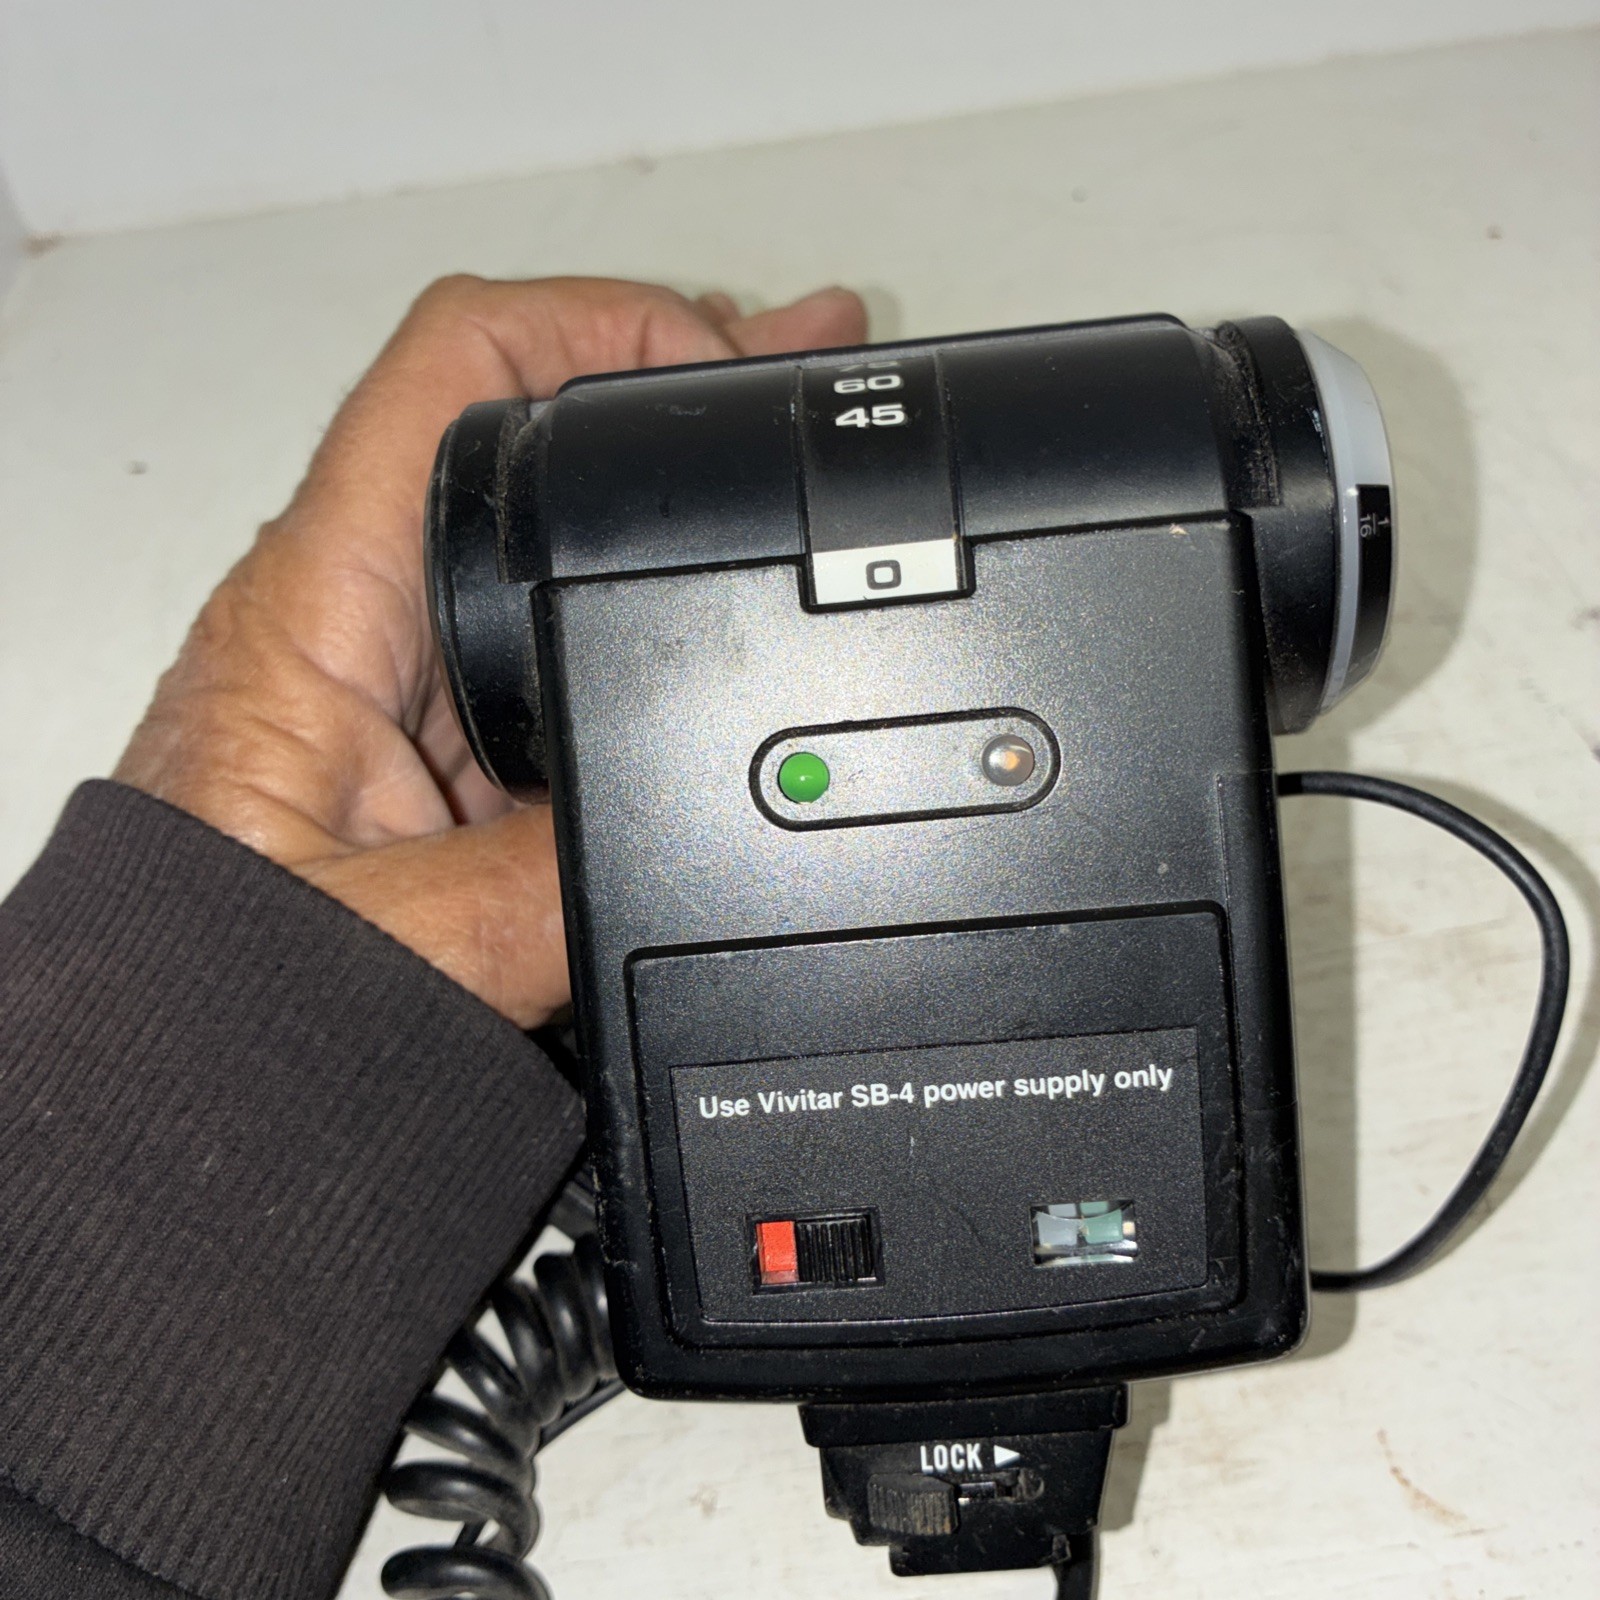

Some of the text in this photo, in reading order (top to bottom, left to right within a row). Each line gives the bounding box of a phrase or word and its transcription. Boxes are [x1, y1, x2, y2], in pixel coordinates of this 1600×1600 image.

[833, 374, 902, 394] 60
[835, 404, 906, 428] 45
[699, 1063, 1173, 1119] Use Vivitar SB-4 power supply only
[920, 1443, 983, 1475] LOCK
